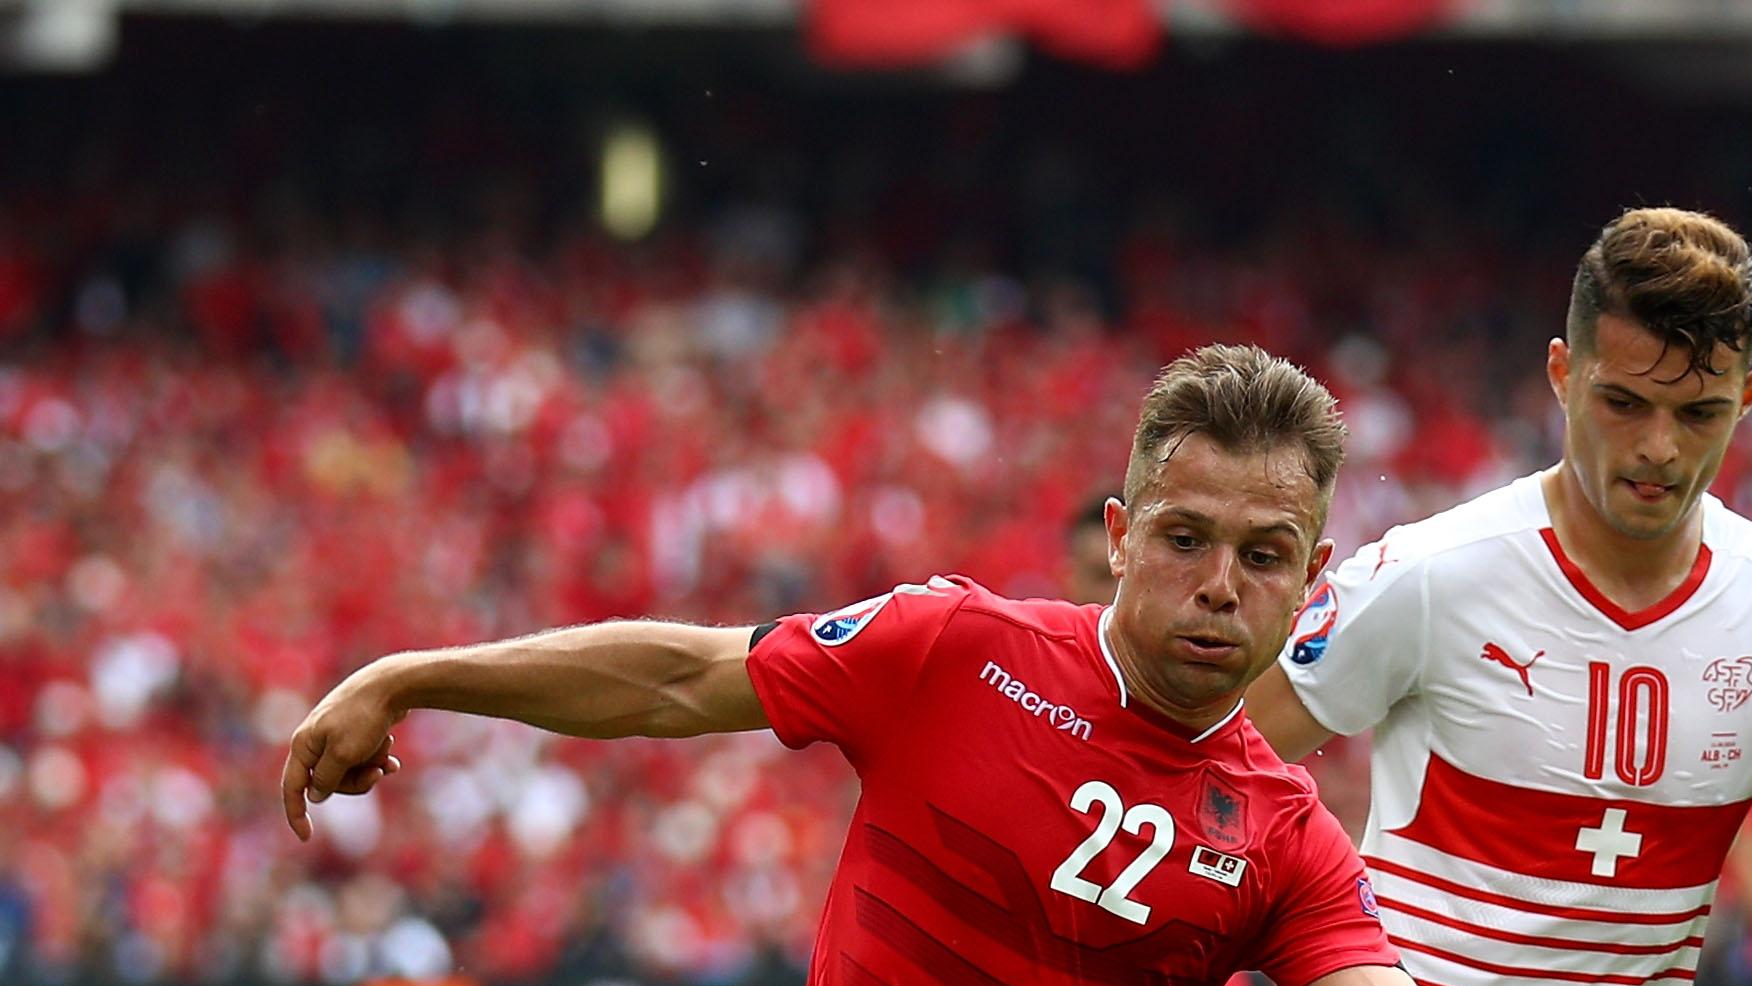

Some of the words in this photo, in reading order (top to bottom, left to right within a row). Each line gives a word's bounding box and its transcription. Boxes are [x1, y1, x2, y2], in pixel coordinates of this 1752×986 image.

[979, 660, 1094, 742] macron
[1583, 660, 1670, 788] 10
[1701, 750, 1720, 762] ALB
[1049, 779, 1176, 926] 22
